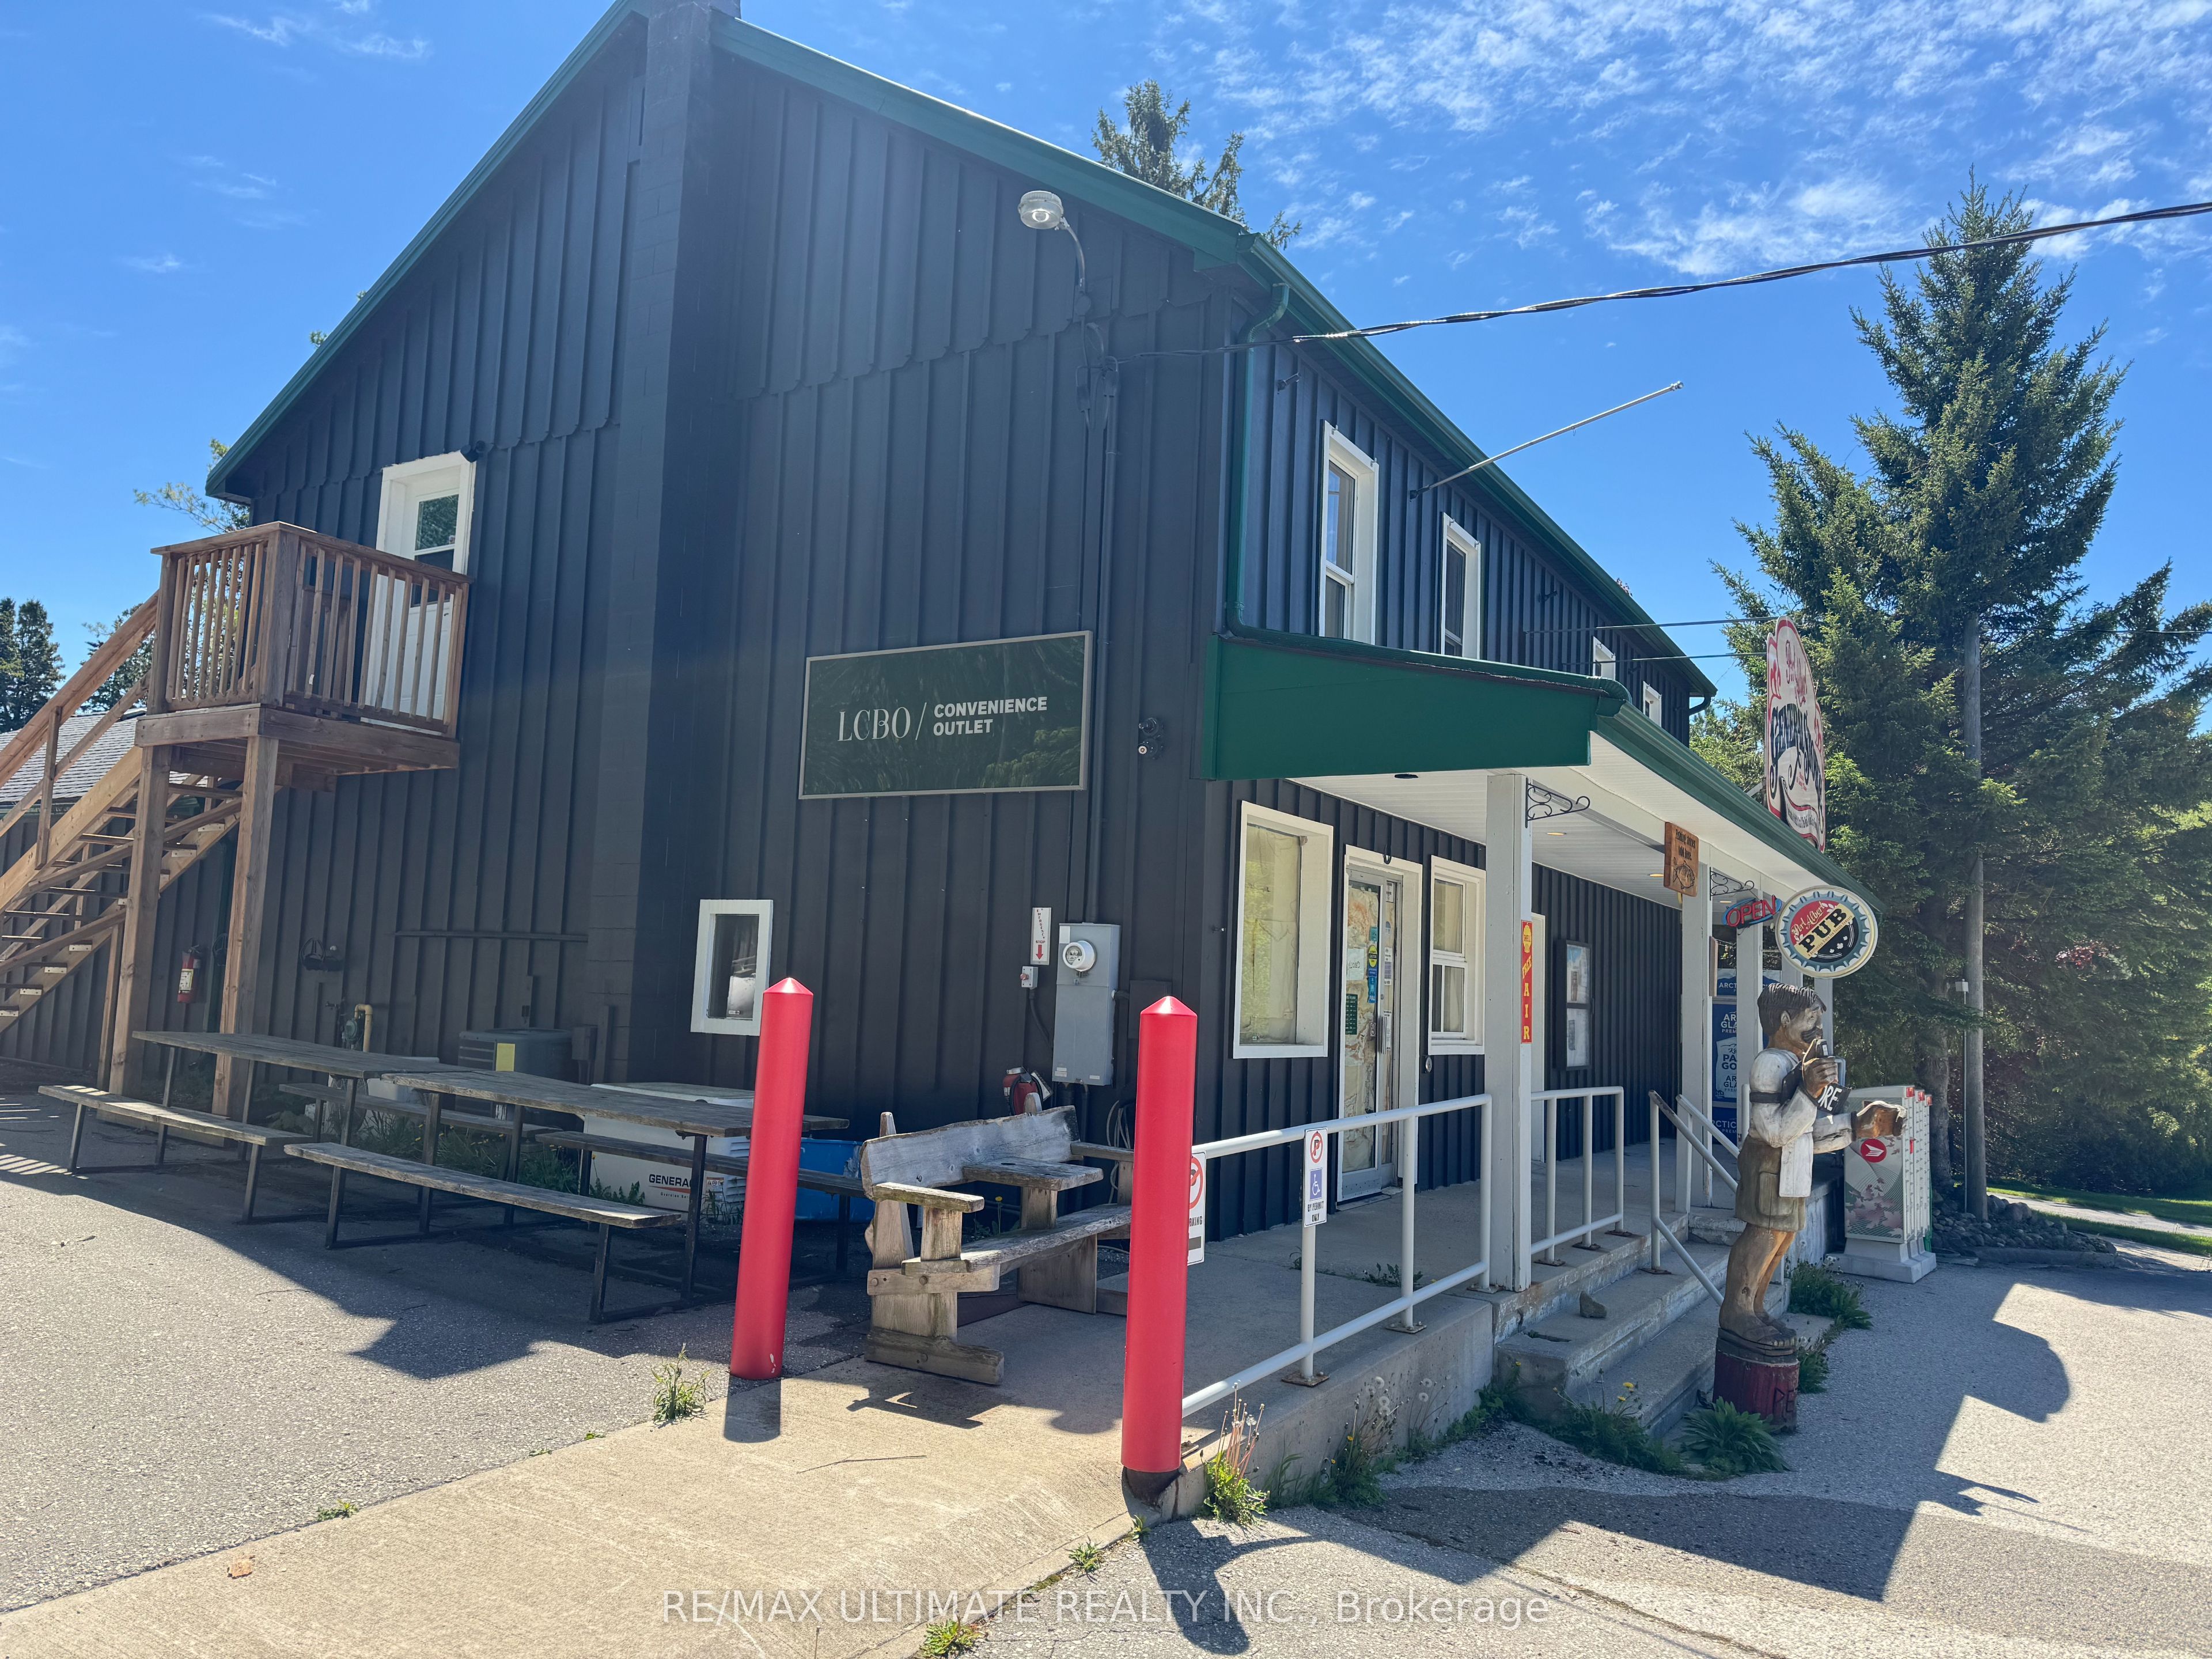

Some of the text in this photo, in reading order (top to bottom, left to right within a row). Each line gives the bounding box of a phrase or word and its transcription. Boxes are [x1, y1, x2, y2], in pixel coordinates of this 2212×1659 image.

[933, 696, 1048, 718] CONVENIENCE
[837, 706, 911, 741] LCBO
[933, 718, 994, 736] OUTLET
[1726, 895, 1775, 927] OPEN
[1791, 901, 1825, 935] Port Albert
[1798, 908, 1847, 953] PUB
[1522, 955, 1532, 979] FREE
[649, 1173, 692, 1188] GENERA
[1312, 1201, 1324, 1210] PERMIT
[1312, 1213, 1320, 1222] ONLY
